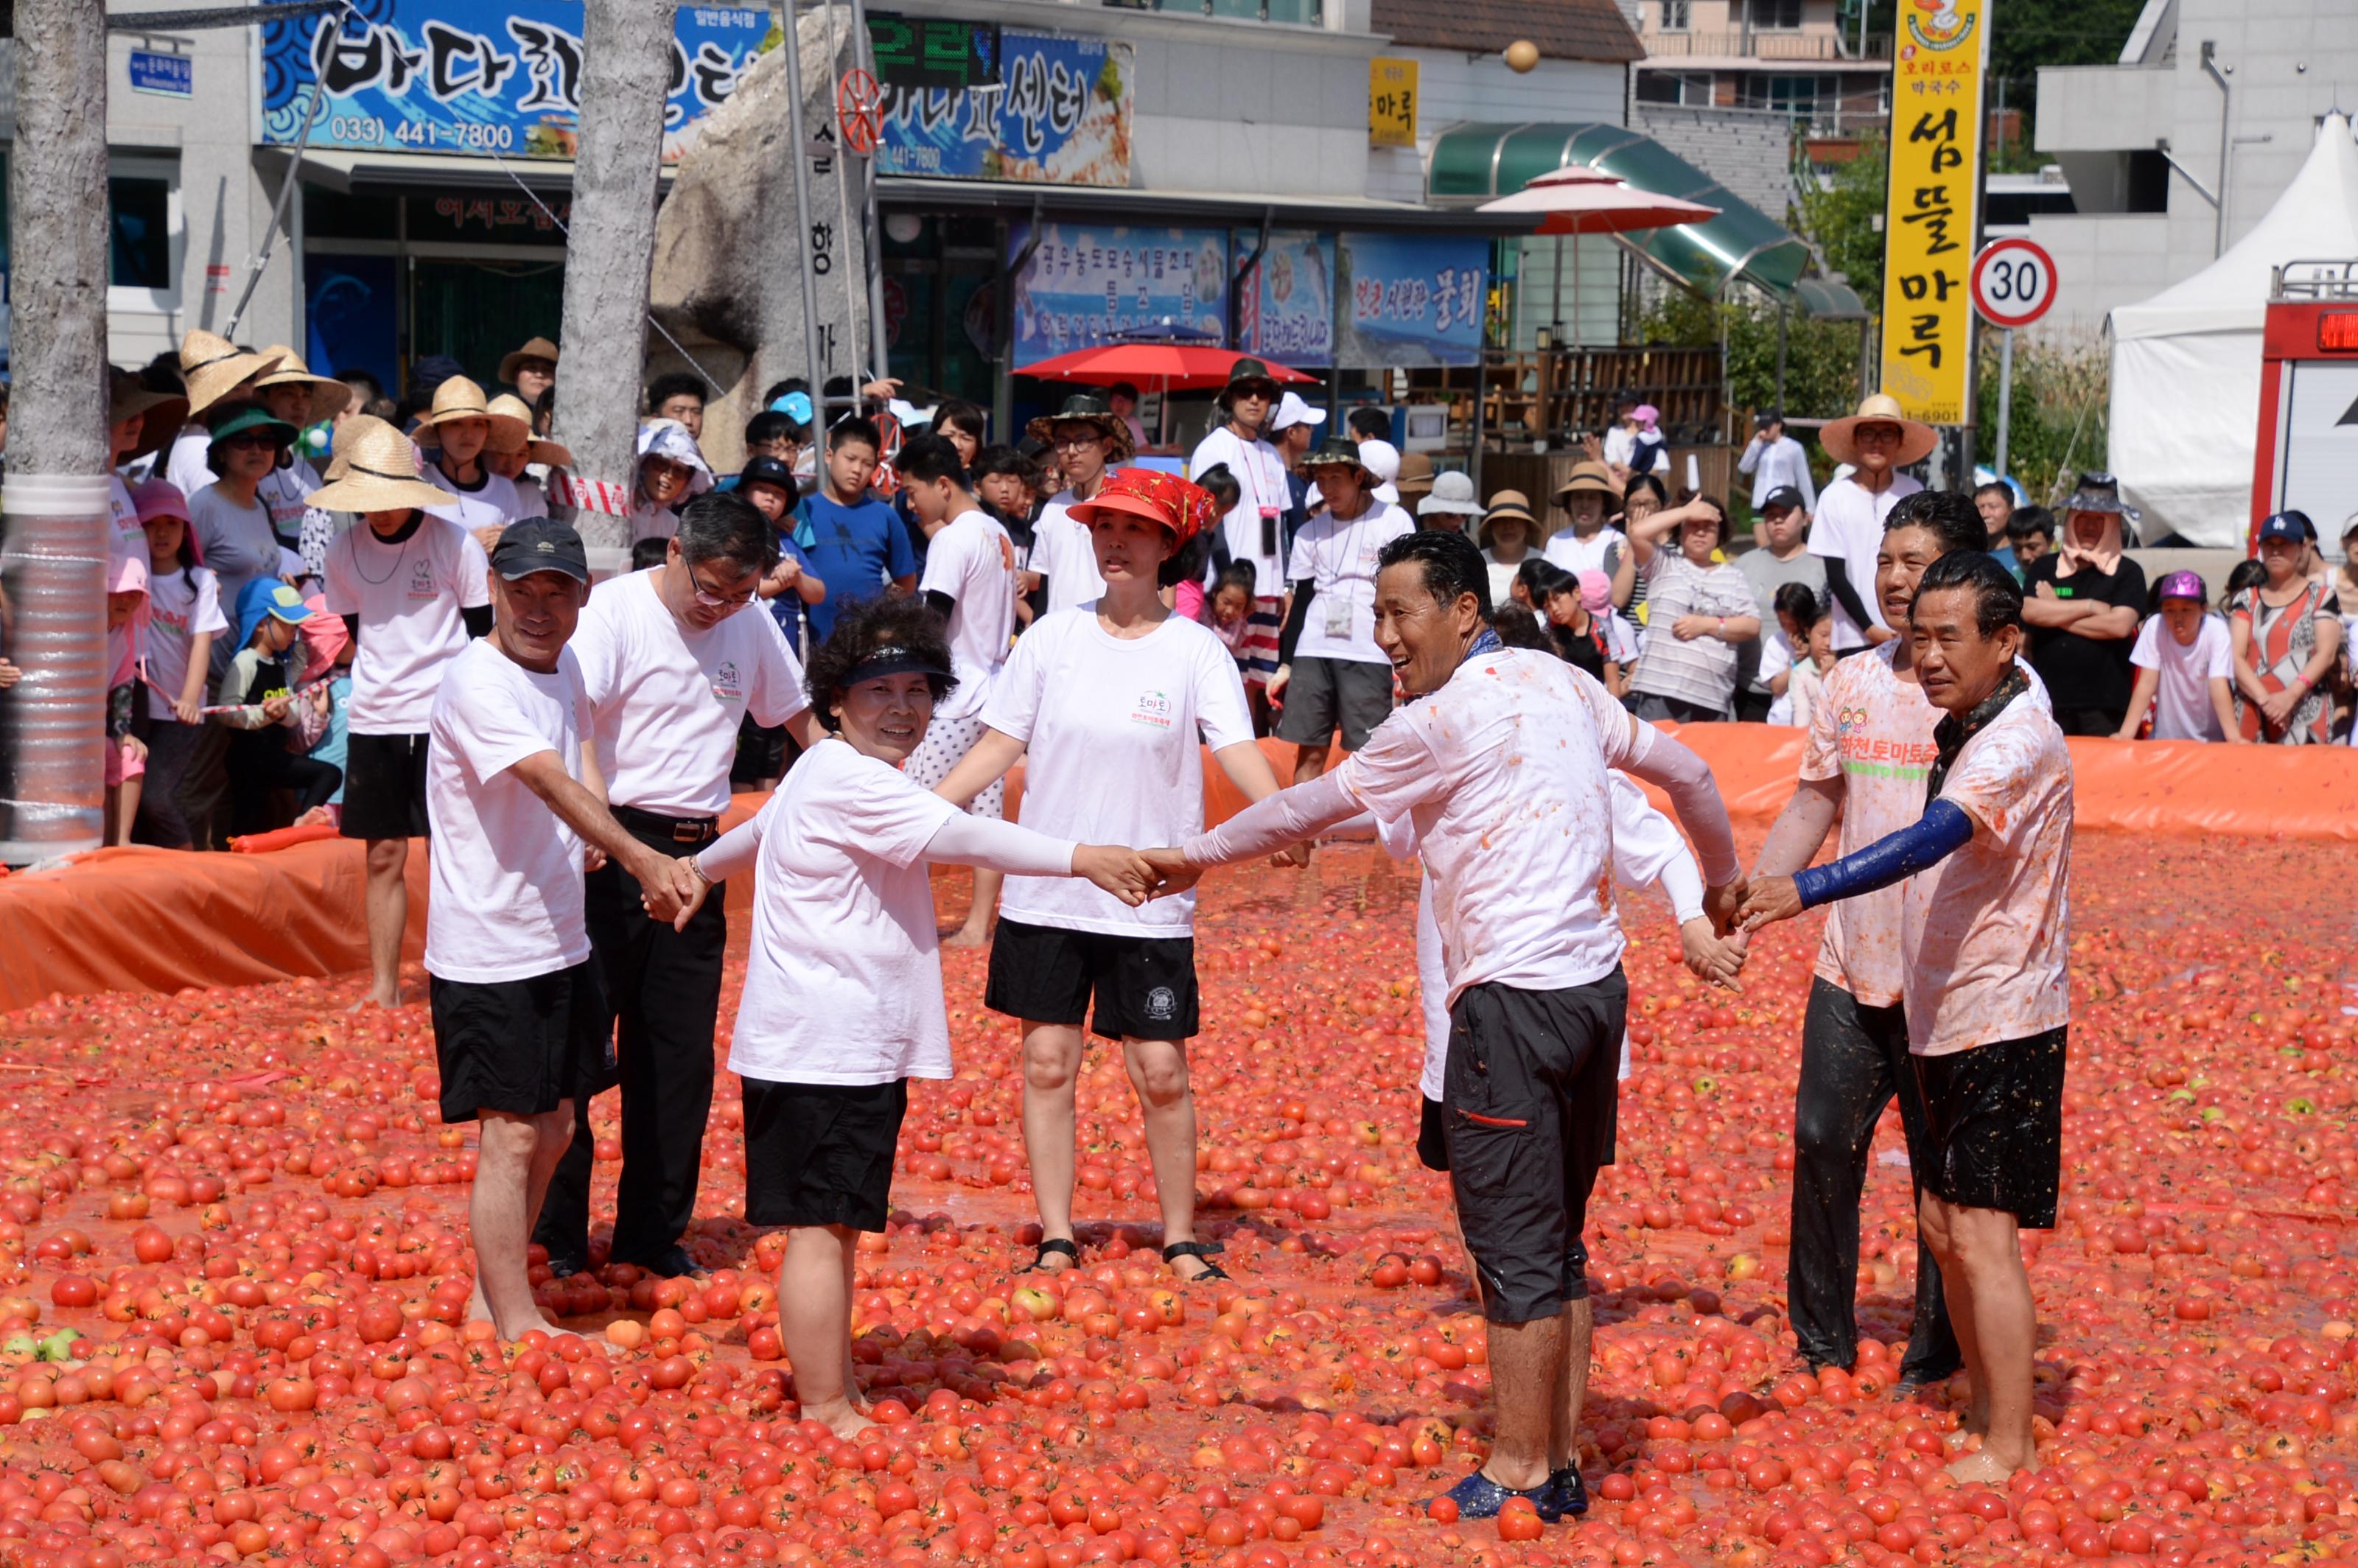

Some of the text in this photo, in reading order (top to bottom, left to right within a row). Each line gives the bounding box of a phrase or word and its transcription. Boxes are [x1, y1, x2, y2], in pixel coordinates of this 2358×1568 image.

[695, 10, 755, 28] 일반음식점
[1903, 60, 1971, 75] 오리로스
[1911, 79, 1961, 96] 막국수
[331, 116, 514, 149] 033) 441-7800
[1899, 108, 1963, 369] 섬뜰마루
[1991, 260, 2038, 303] 30
[1432, 267, 1480, 332] 물회
[1138, 696, 1166, 712] 토마토
[1840, 735, 1940, 766] 화천토마토축
